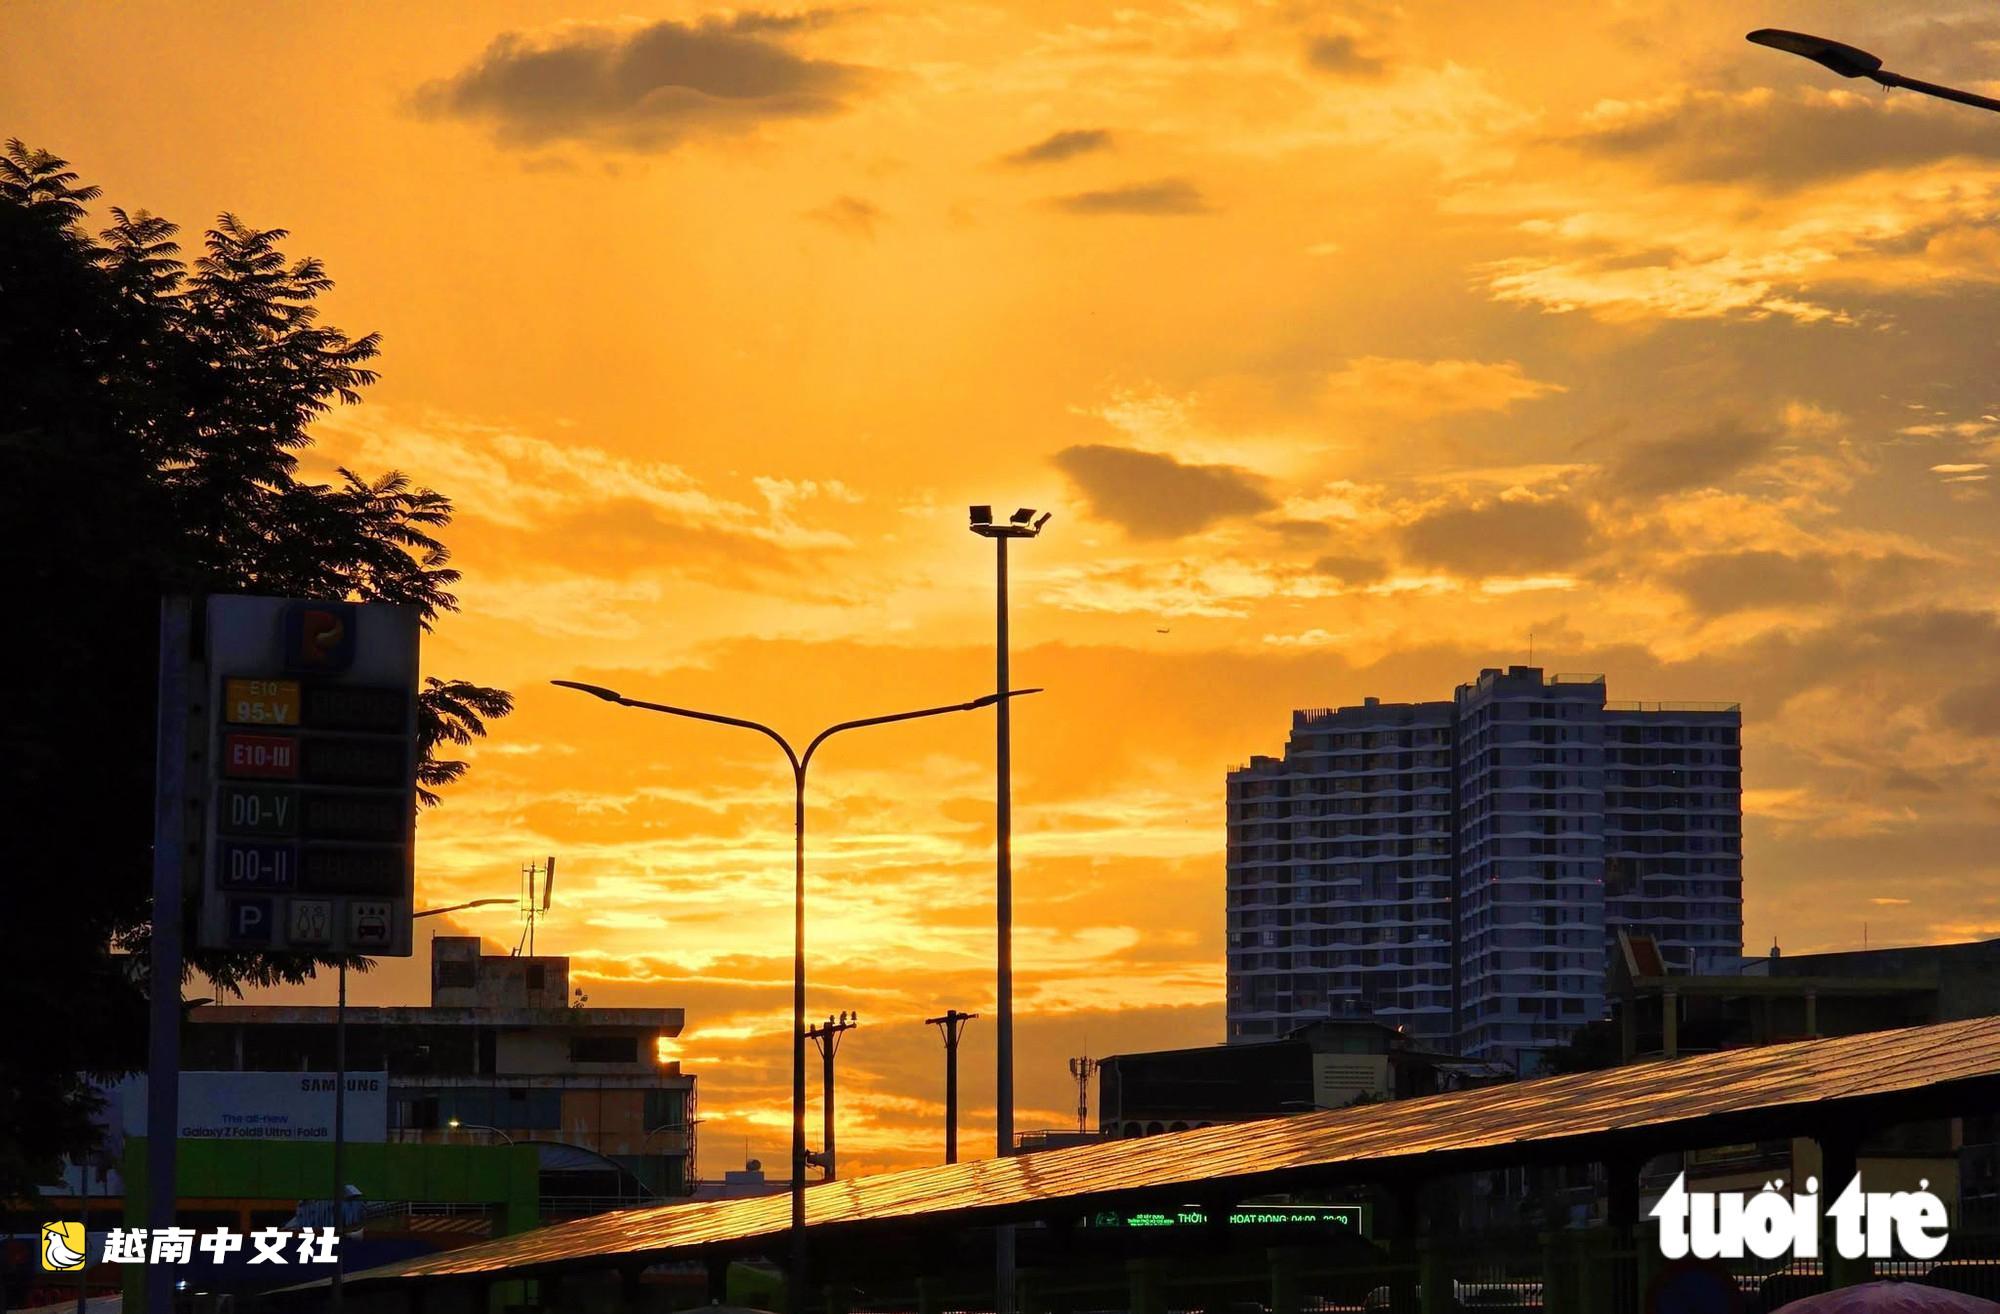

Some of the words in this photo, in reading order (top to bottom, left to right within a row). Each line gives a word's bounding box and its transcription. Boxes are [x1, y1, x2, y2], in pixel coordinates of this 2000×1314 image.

[250, 681, 277, 696] E10
[237, 702, 289, 722] 95-V
[233, 743, 290, 767] E10-III
[231, 793, 289, 828] DO-V
[231, 849, 287, 883] DO-II
[239, 905, 263, 937] P
[301, 1079, 379, 1092] SAMUNG
[222, 1114, 243, 1124] The
[182, 1127, 223, 1139] Galaxy
[224, 1127, 233, 1137] Z
[265, 1127, 292, 1138] Ultra
